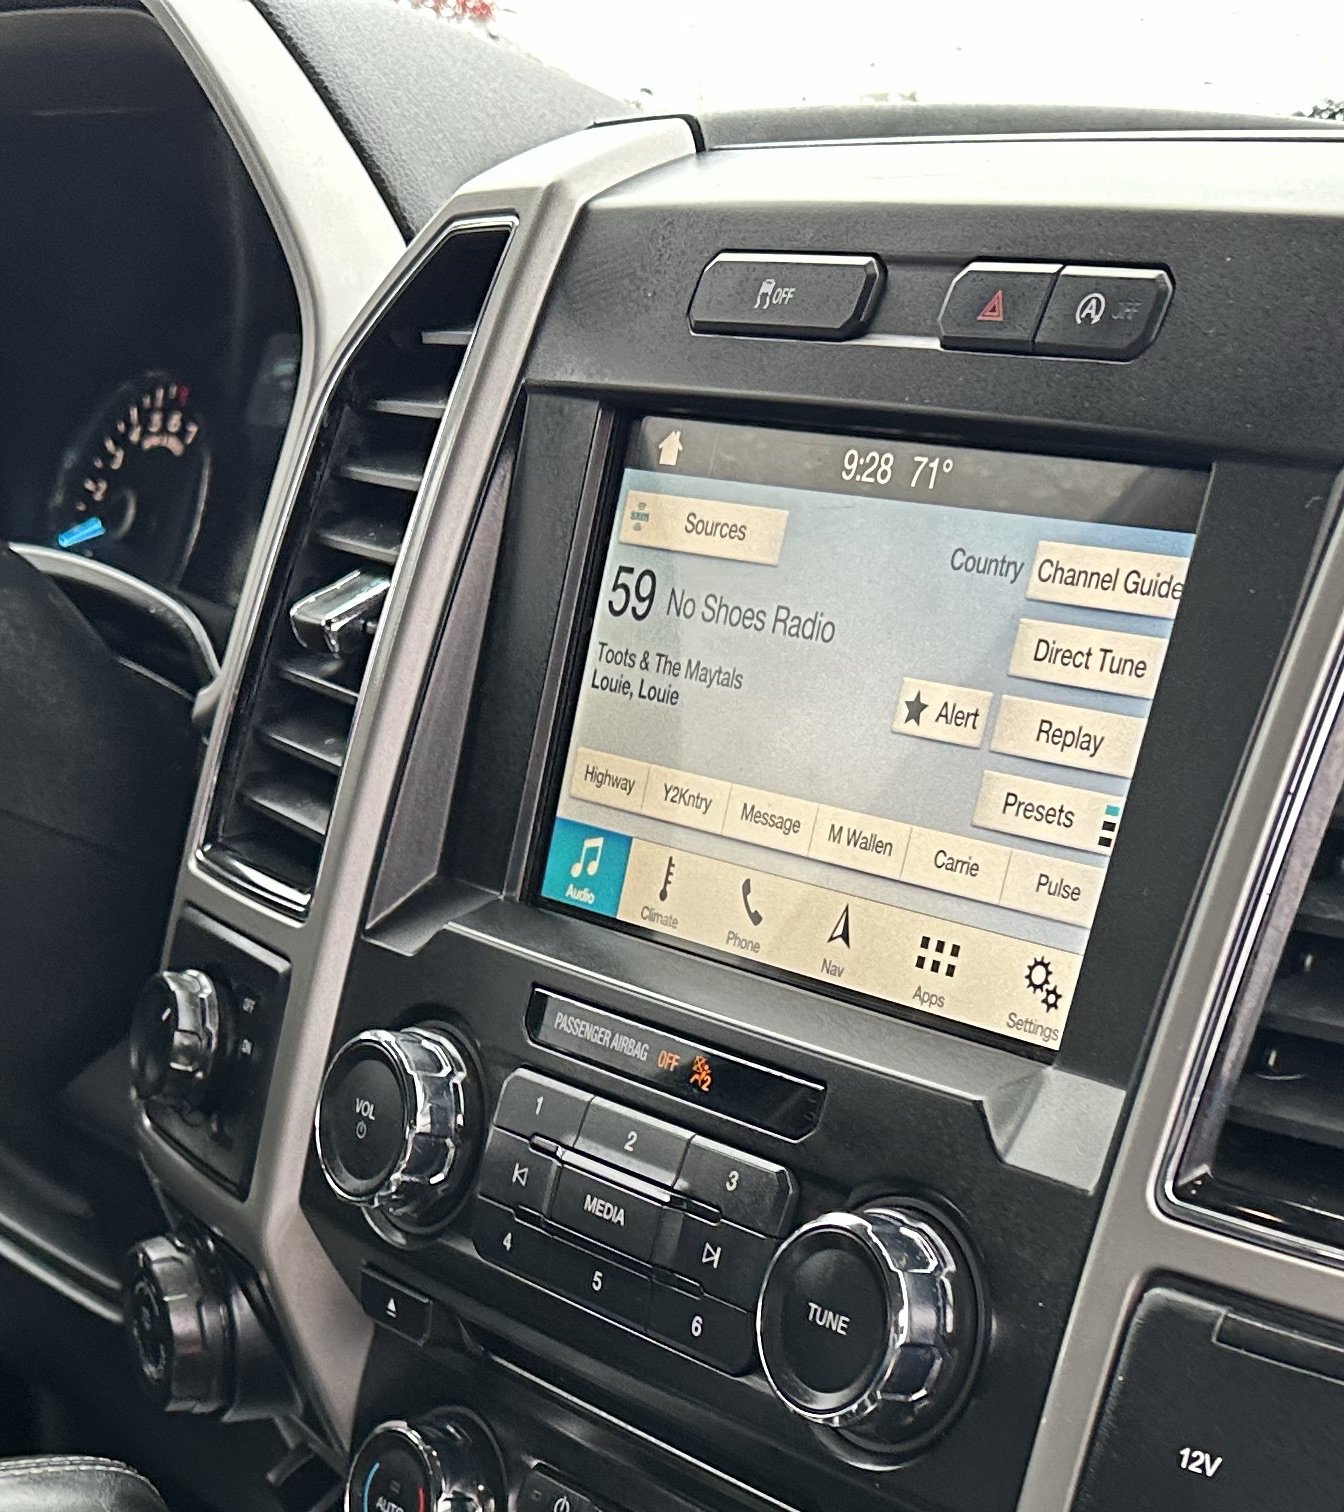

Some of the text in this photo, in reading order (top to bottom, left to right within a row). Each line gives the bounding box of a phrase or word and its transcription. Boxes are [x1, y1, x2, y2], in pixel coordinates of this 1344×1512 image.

[773, 286, 796, 304] OFF
[841, 449, 954, 489] 9:28 71°
[685, 512, 747, 541] Sources
[950, 547, 1024, 584] Country
[1037, 558, 1184, 601] Channel Guide
[608, 565, 836, 643] 59 No Shoes Radio
[598, 641, 743, 690] Toots & The Maytals
[1033, 638, 1147, 678] Direct Tune
[591, 669, 679, 706] Louie, Louie
[935, 701, 980, 730] Alert
[1035, 719, 1105, 757] Replay
[584, 764, 635, 796] Highway
[663, 783, 713, 815] Y2Kntry
[1002, 792, 1075, 829] Presets
[741, 802, 801, 836] Message
[827, 823, 893, 857] M Wallen
[934, 849, 979, 877] Carrie
[565, 883, 595, 904] Audio
[1035, 873, 1082, 902] Pulse
[640, 905, 679, 930] Climate
[726, 930, 761, 954] Phone
[820, 958, 844, 978] Nav
[912, 985, 945, 1009] Apps
[554, 1011, 681, 1071] PASSENGER AIRBAG OFF
[1006, 1012, 1060, 1042] Settings
[356, 1097, 376, 1122] VOL
[535, 1096, 544, 1115] 1
[624, 1131, 638, 1151] 2
[725, 1170, 739, 1191] 3
[584, 1195, 626, 1226] MEDIA
[502, 1233, 512, 1251] 4
[592, 1270, 602, 1291] 5
[691, 1315, 703, 1337] 6
[807, 1302, 850, 1335] TUNE
[1178, 1446, 1223, 1478] 12V
